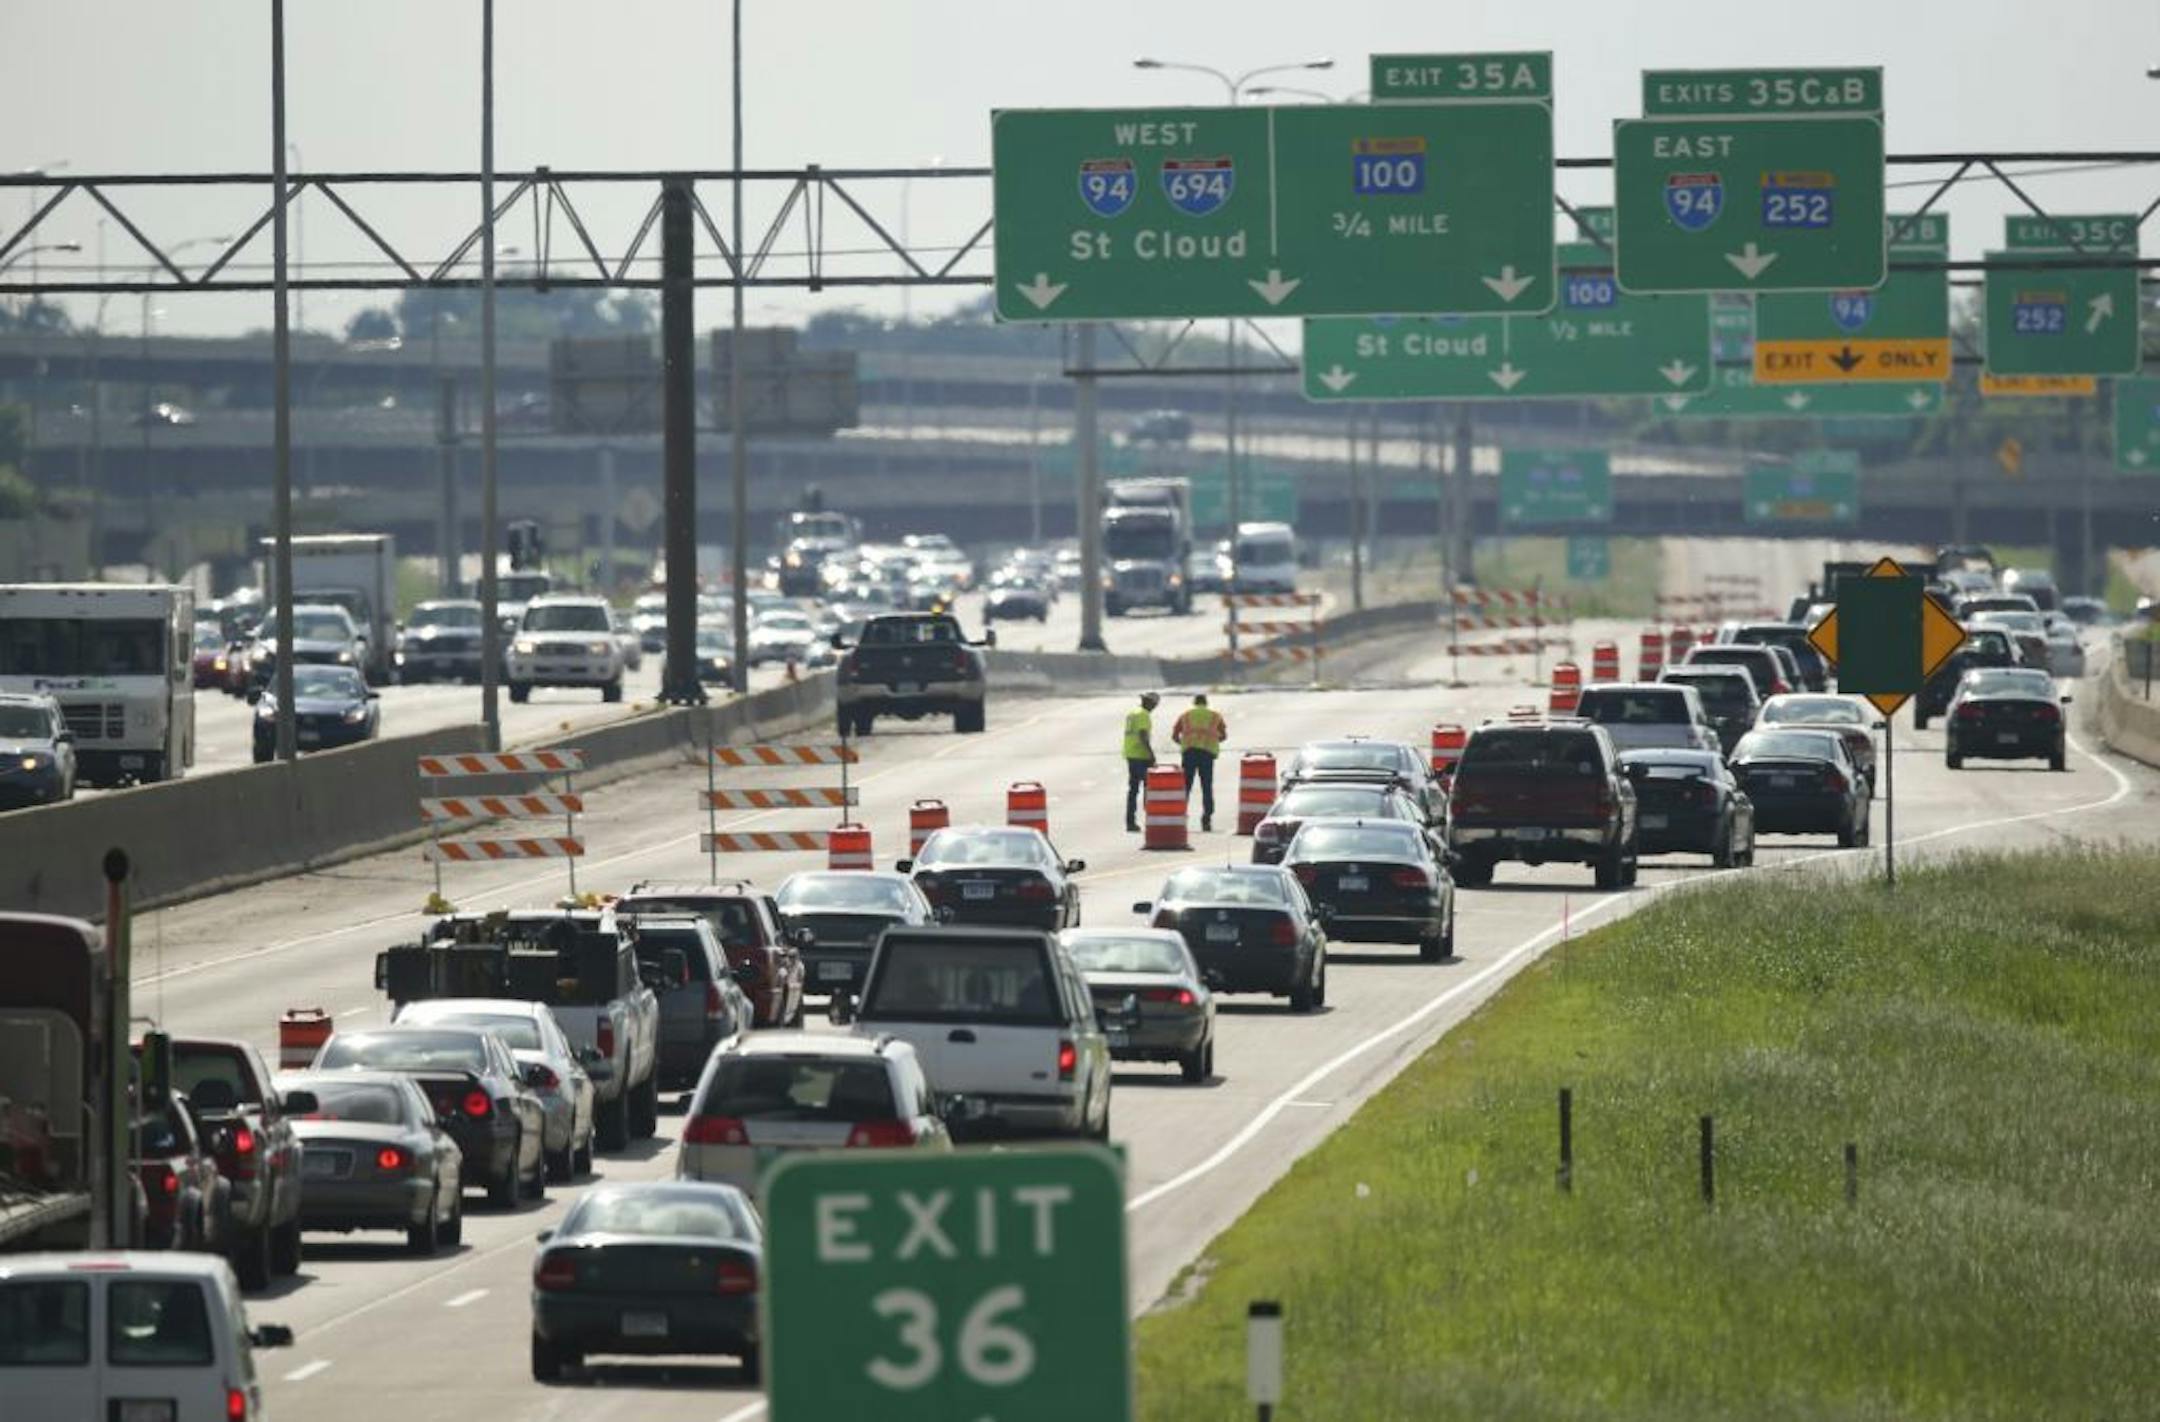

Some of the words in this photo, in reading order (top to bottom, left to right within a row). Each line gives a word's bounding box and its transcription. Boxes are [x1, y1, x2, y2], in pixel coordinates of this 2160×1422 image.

[1386, 67, 1442, 86] EXIT
[1456, 61, 1536, 90] 35A
[1659, 83, 1735, 103] EXITS
[1749, 77, 1865, 105] 35C&B
[1114, 122, 1197, 146] WEST
[1653, 135, 1733, 158] EAST
[1088, 175, 1129, 201] 94
[1170, 173, 1226, 200] 694
[1361, 161, 1417, 188] 100
[1674, 188, 1715, 216] 94
[1767, 194, 1828, 222] 252
[1389, 213, 1450, 234] MILE
[1070, 229, 1112, 260] St
[1134, 228, 1247, 259] Cloud
[1569, 281, 1612, 304] 100
[1835, 299, 1867, 319] 94
[2015, 307, 2063, 331] 252
[1588, 321, 1633, 336] MILE
[1357, 332, 1388, 357] St
[1404, 332, 1487, 357] Cloud
[1764, 353, 1816, 371] EXIT
[1877, 351, 1938, 369] ONLY
[817, 1183, 1074, 1261] EXIT
[866, 1284, 1036, 1390] 36
